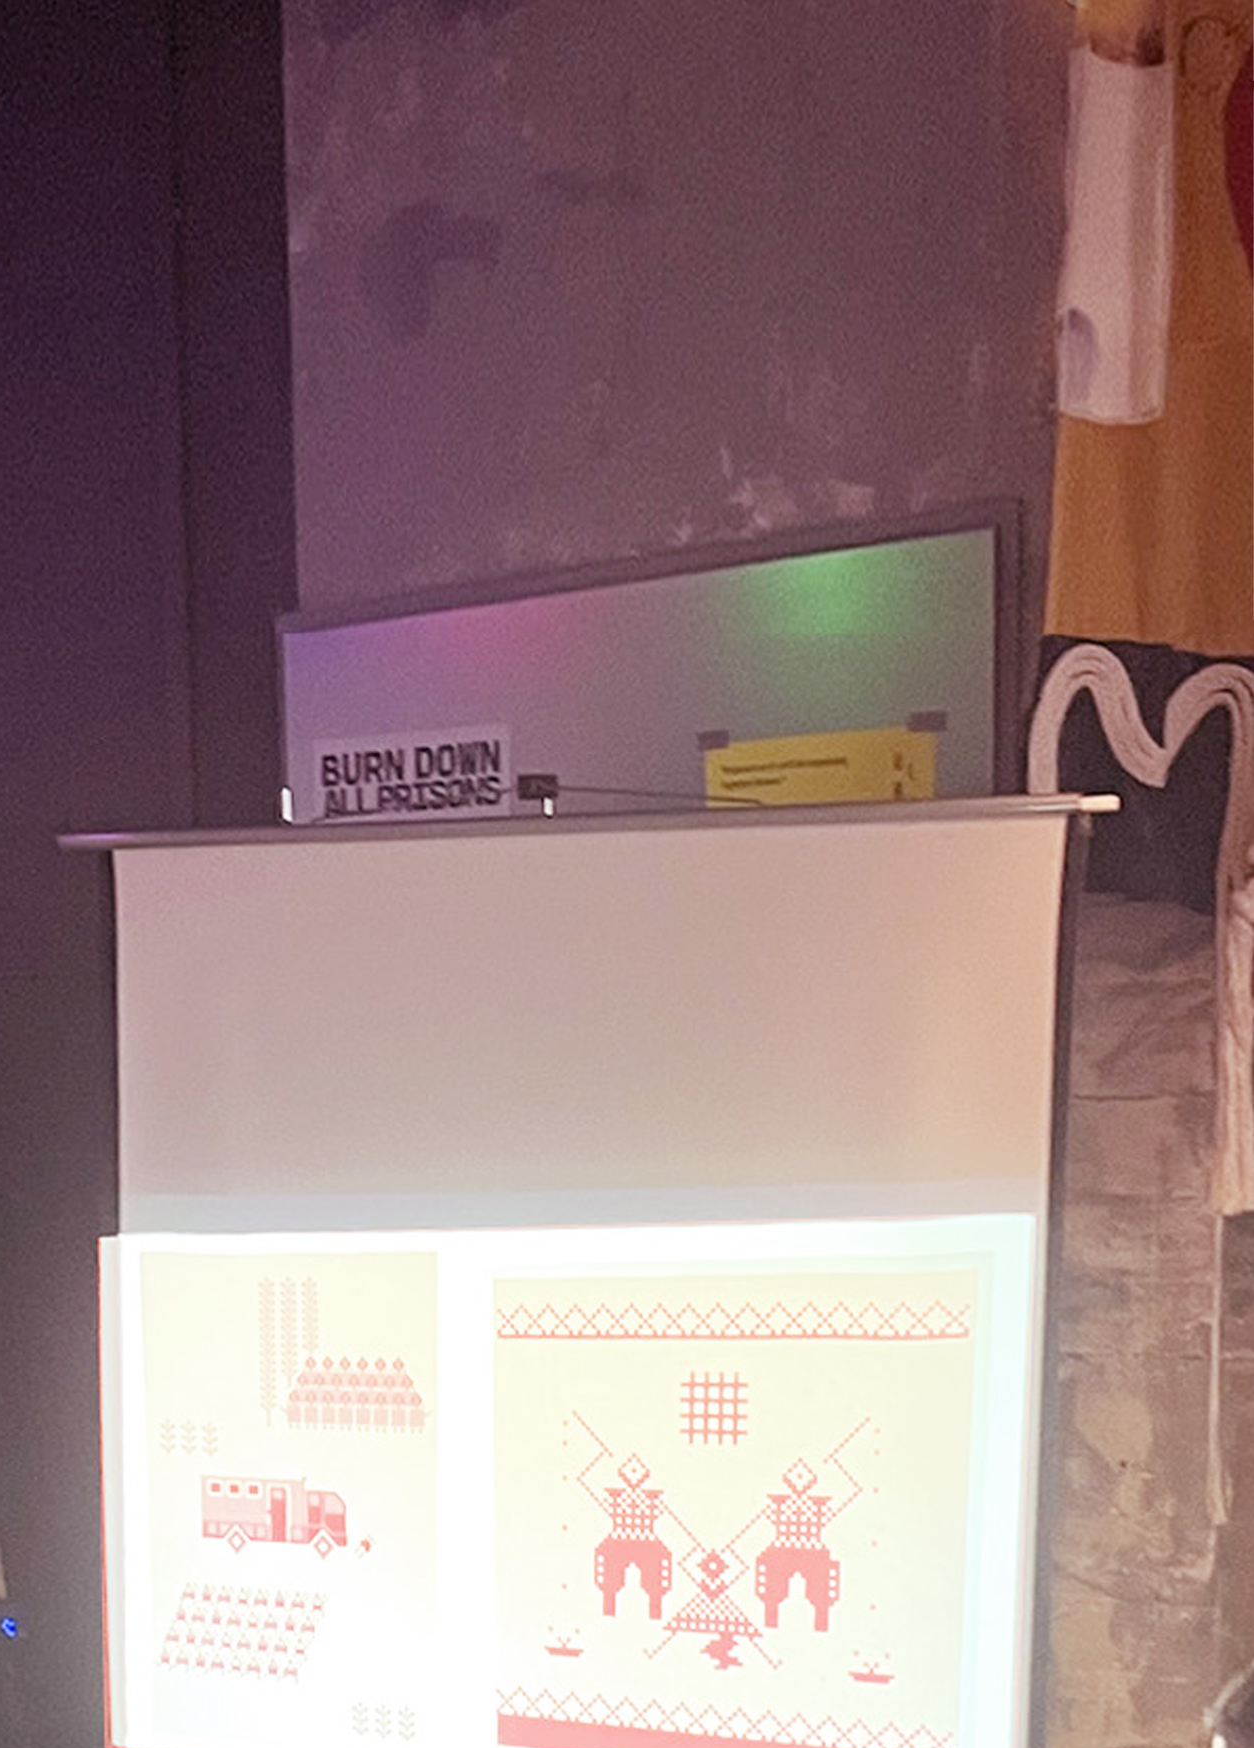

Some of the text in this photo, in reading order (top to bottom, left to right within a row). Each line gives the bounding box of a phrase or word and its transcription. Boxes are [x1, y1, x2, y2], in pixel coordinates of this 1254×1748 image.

[321, 740, 501, 787] BURN DOWN
[324, 775, 501, 818] ALL PRISONS
